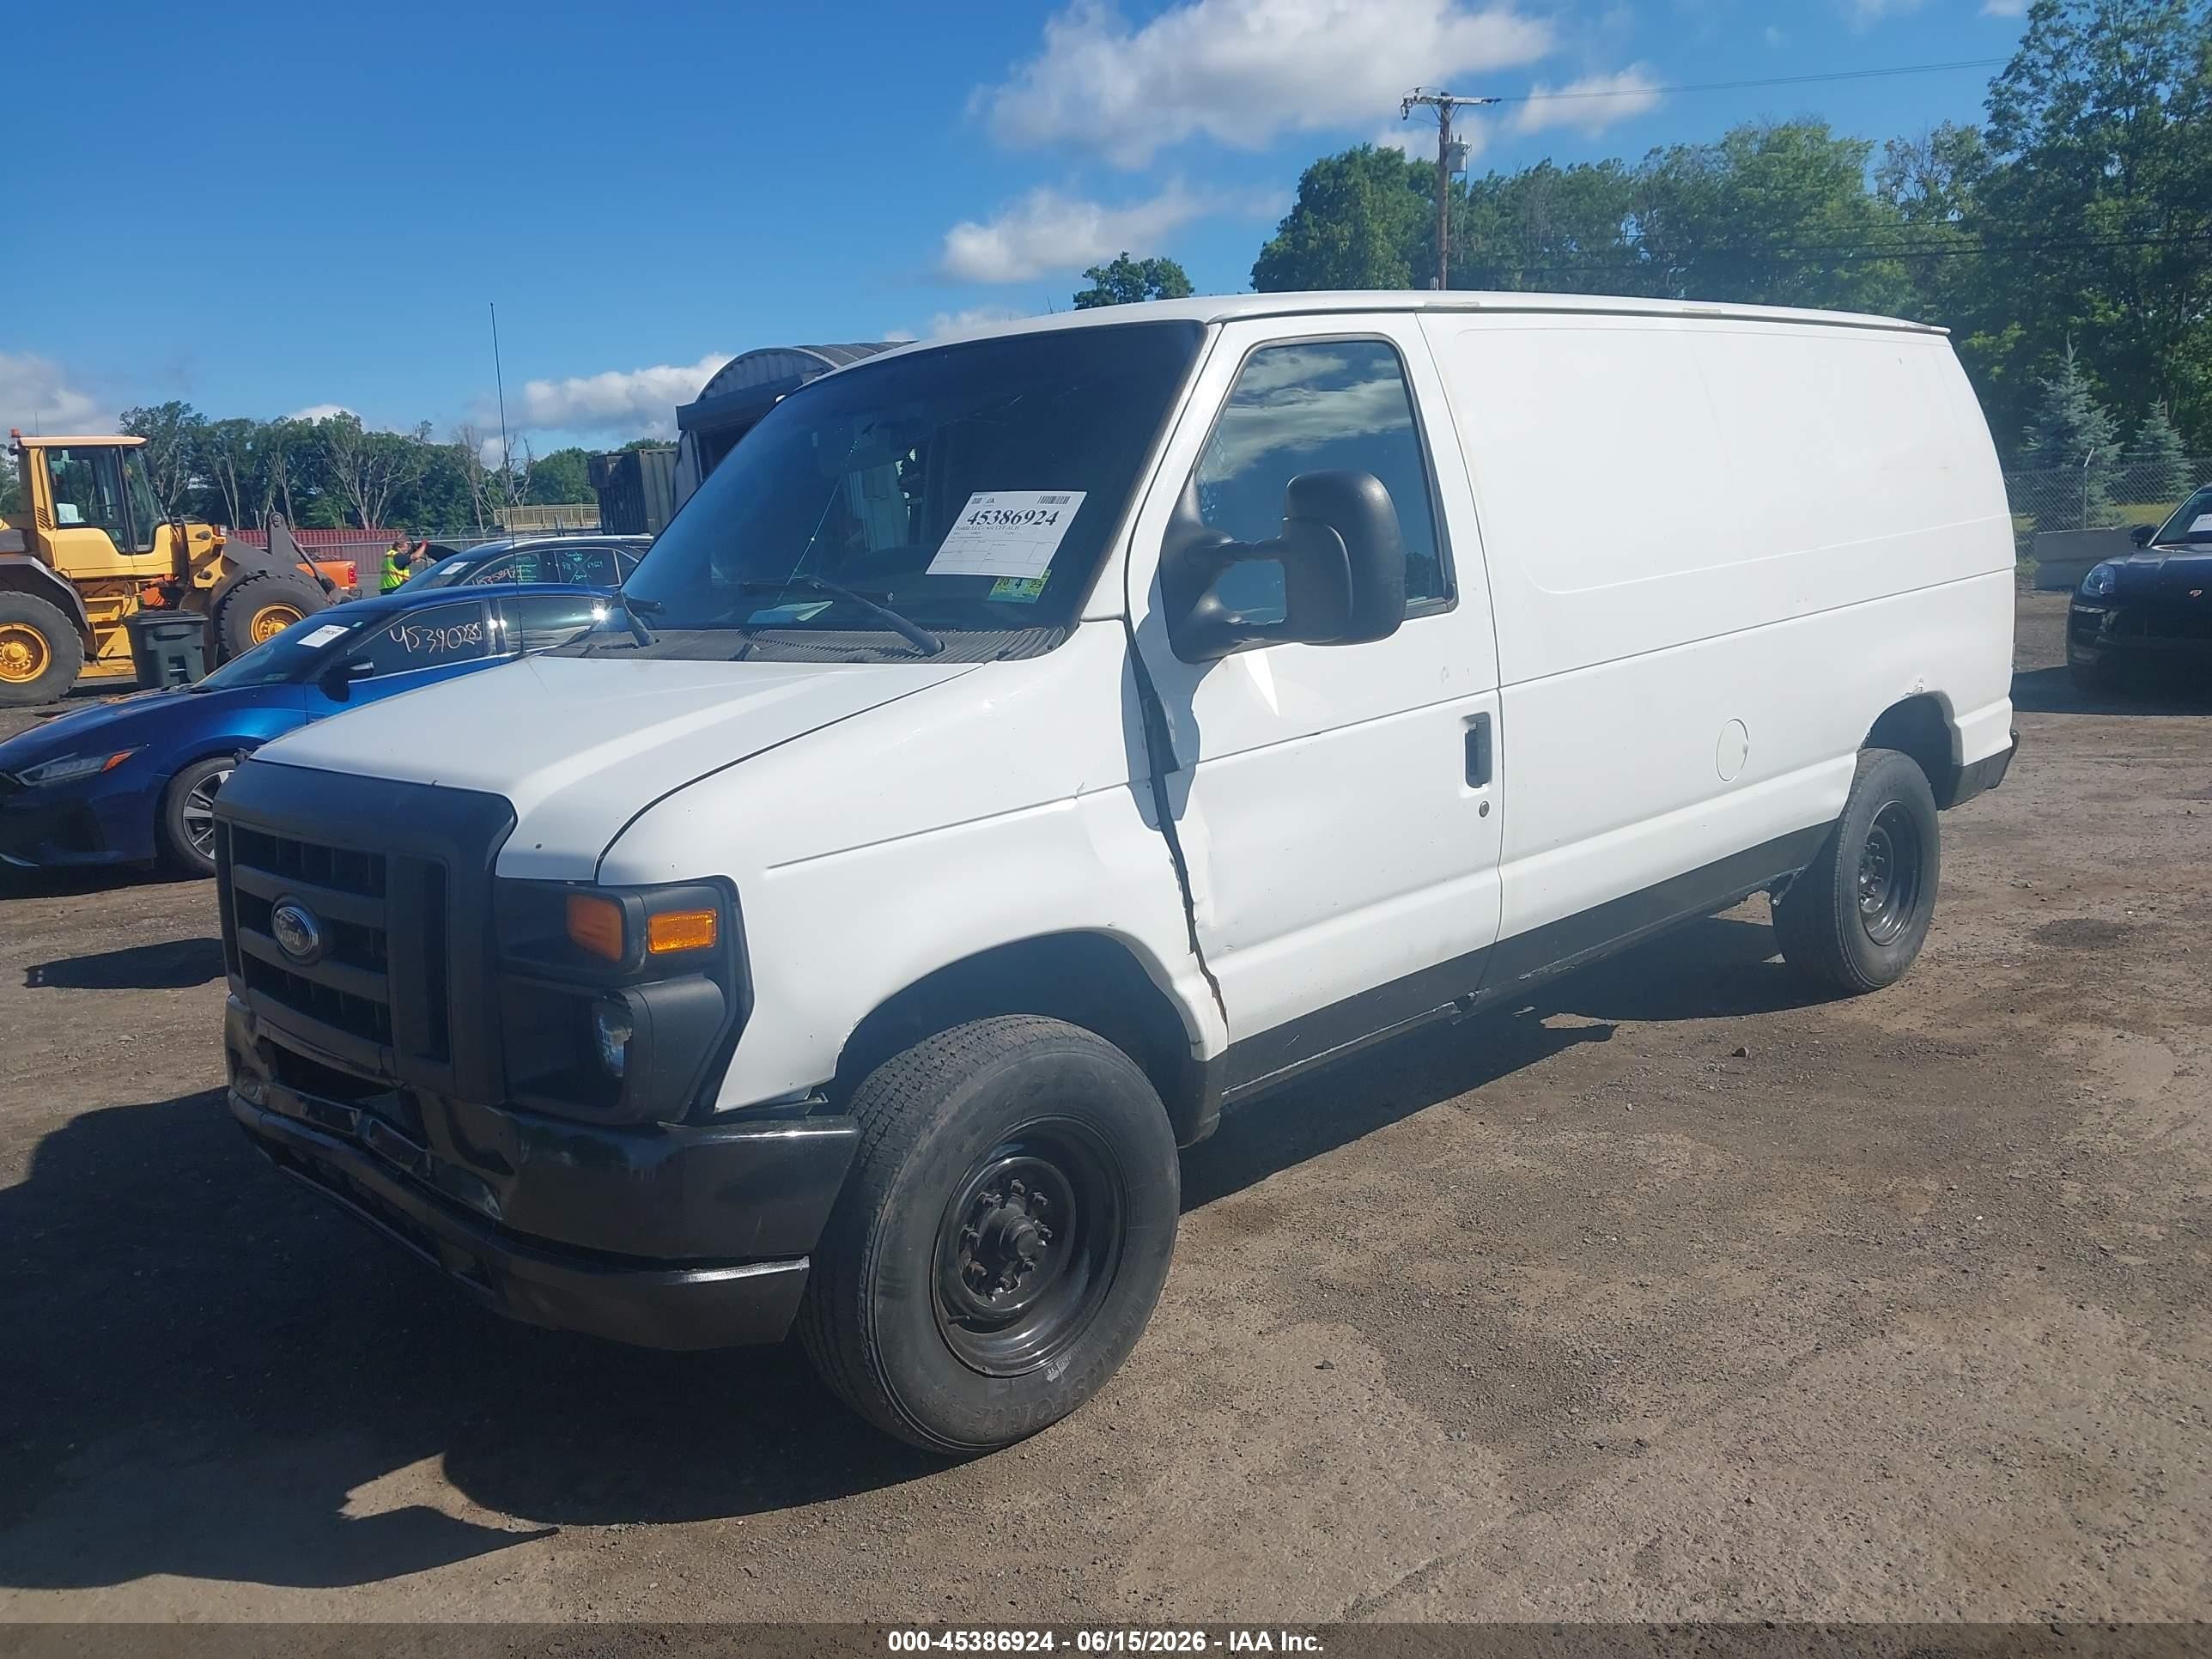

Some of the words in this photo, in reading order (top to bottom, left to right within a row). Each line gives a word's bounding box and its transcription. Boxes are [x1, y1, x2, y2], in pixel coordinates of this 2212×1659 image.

[967, 510, 1059, 526] 45386924
[1015, 578, 1024, 589] 4
[390, 622, 483, 653] 45390285
[278, 912, 305, 946] Ford
